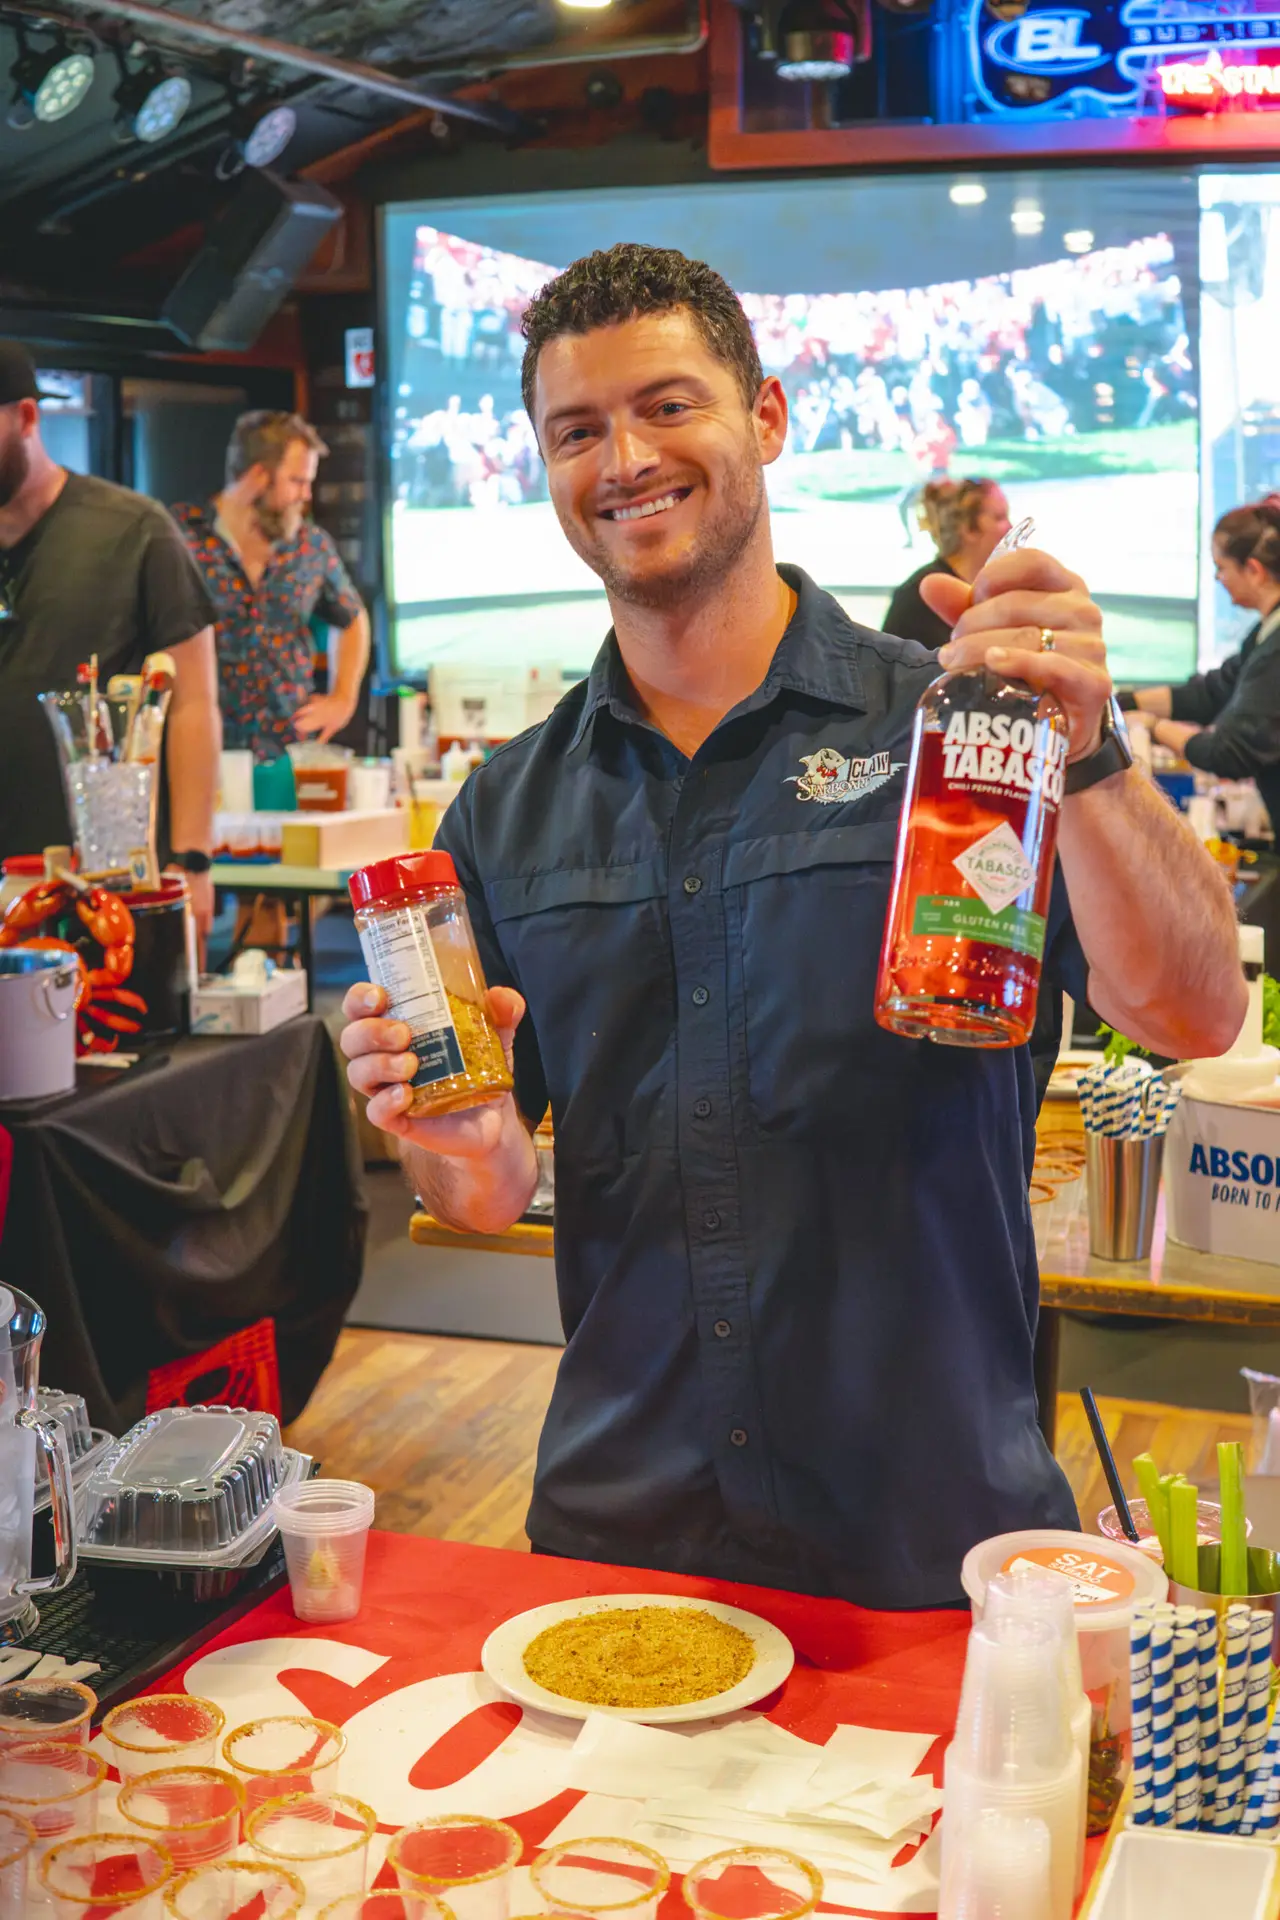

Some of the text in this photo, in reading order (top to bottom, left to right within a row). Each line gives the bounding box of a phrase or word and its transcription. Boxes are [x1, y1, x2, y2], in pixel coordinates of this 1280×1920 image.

[1013, 17, 1102, 62] BL
[851, 753, 890, 779] CLAW
[967, 857, 1030, 881] TABASCO
[952, 913, 999, 930] GLUTEN
[1211, 1182, 1250, 1207] BORN
[1255, 1190, 1271, 1210] TO
[1054, 1553, 1121, 1579] SAT
